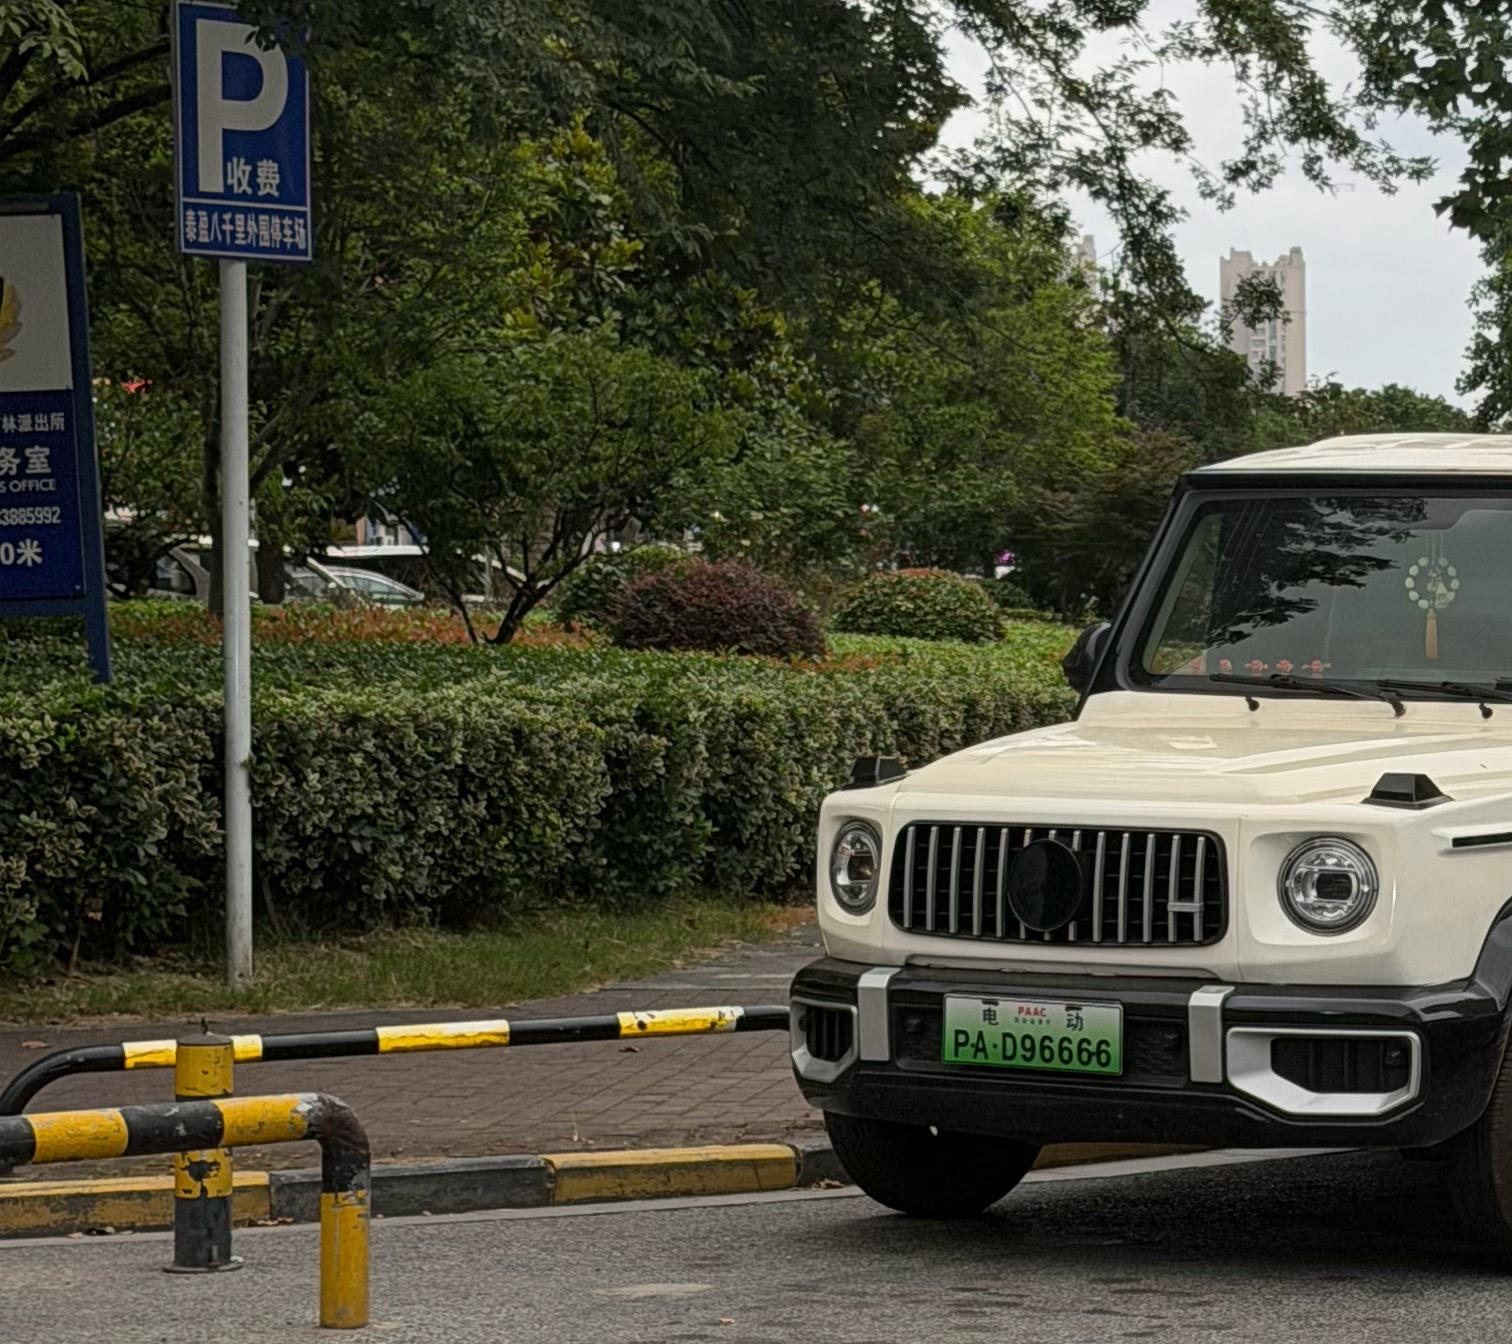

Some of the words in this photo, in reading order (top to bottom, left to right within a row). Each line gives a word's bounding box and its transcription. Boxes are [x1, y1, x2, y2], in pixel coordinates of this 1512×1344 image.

[196, 18, 289, 193] P
[227, 156, 280, 197] 收费
[0, 412, 65, 433] 林派出所
[9, 478, 56, 492] OFFICE
[982, 1008, 999, 1026] 电
[1066, 1013, 1084, 1032] 动
